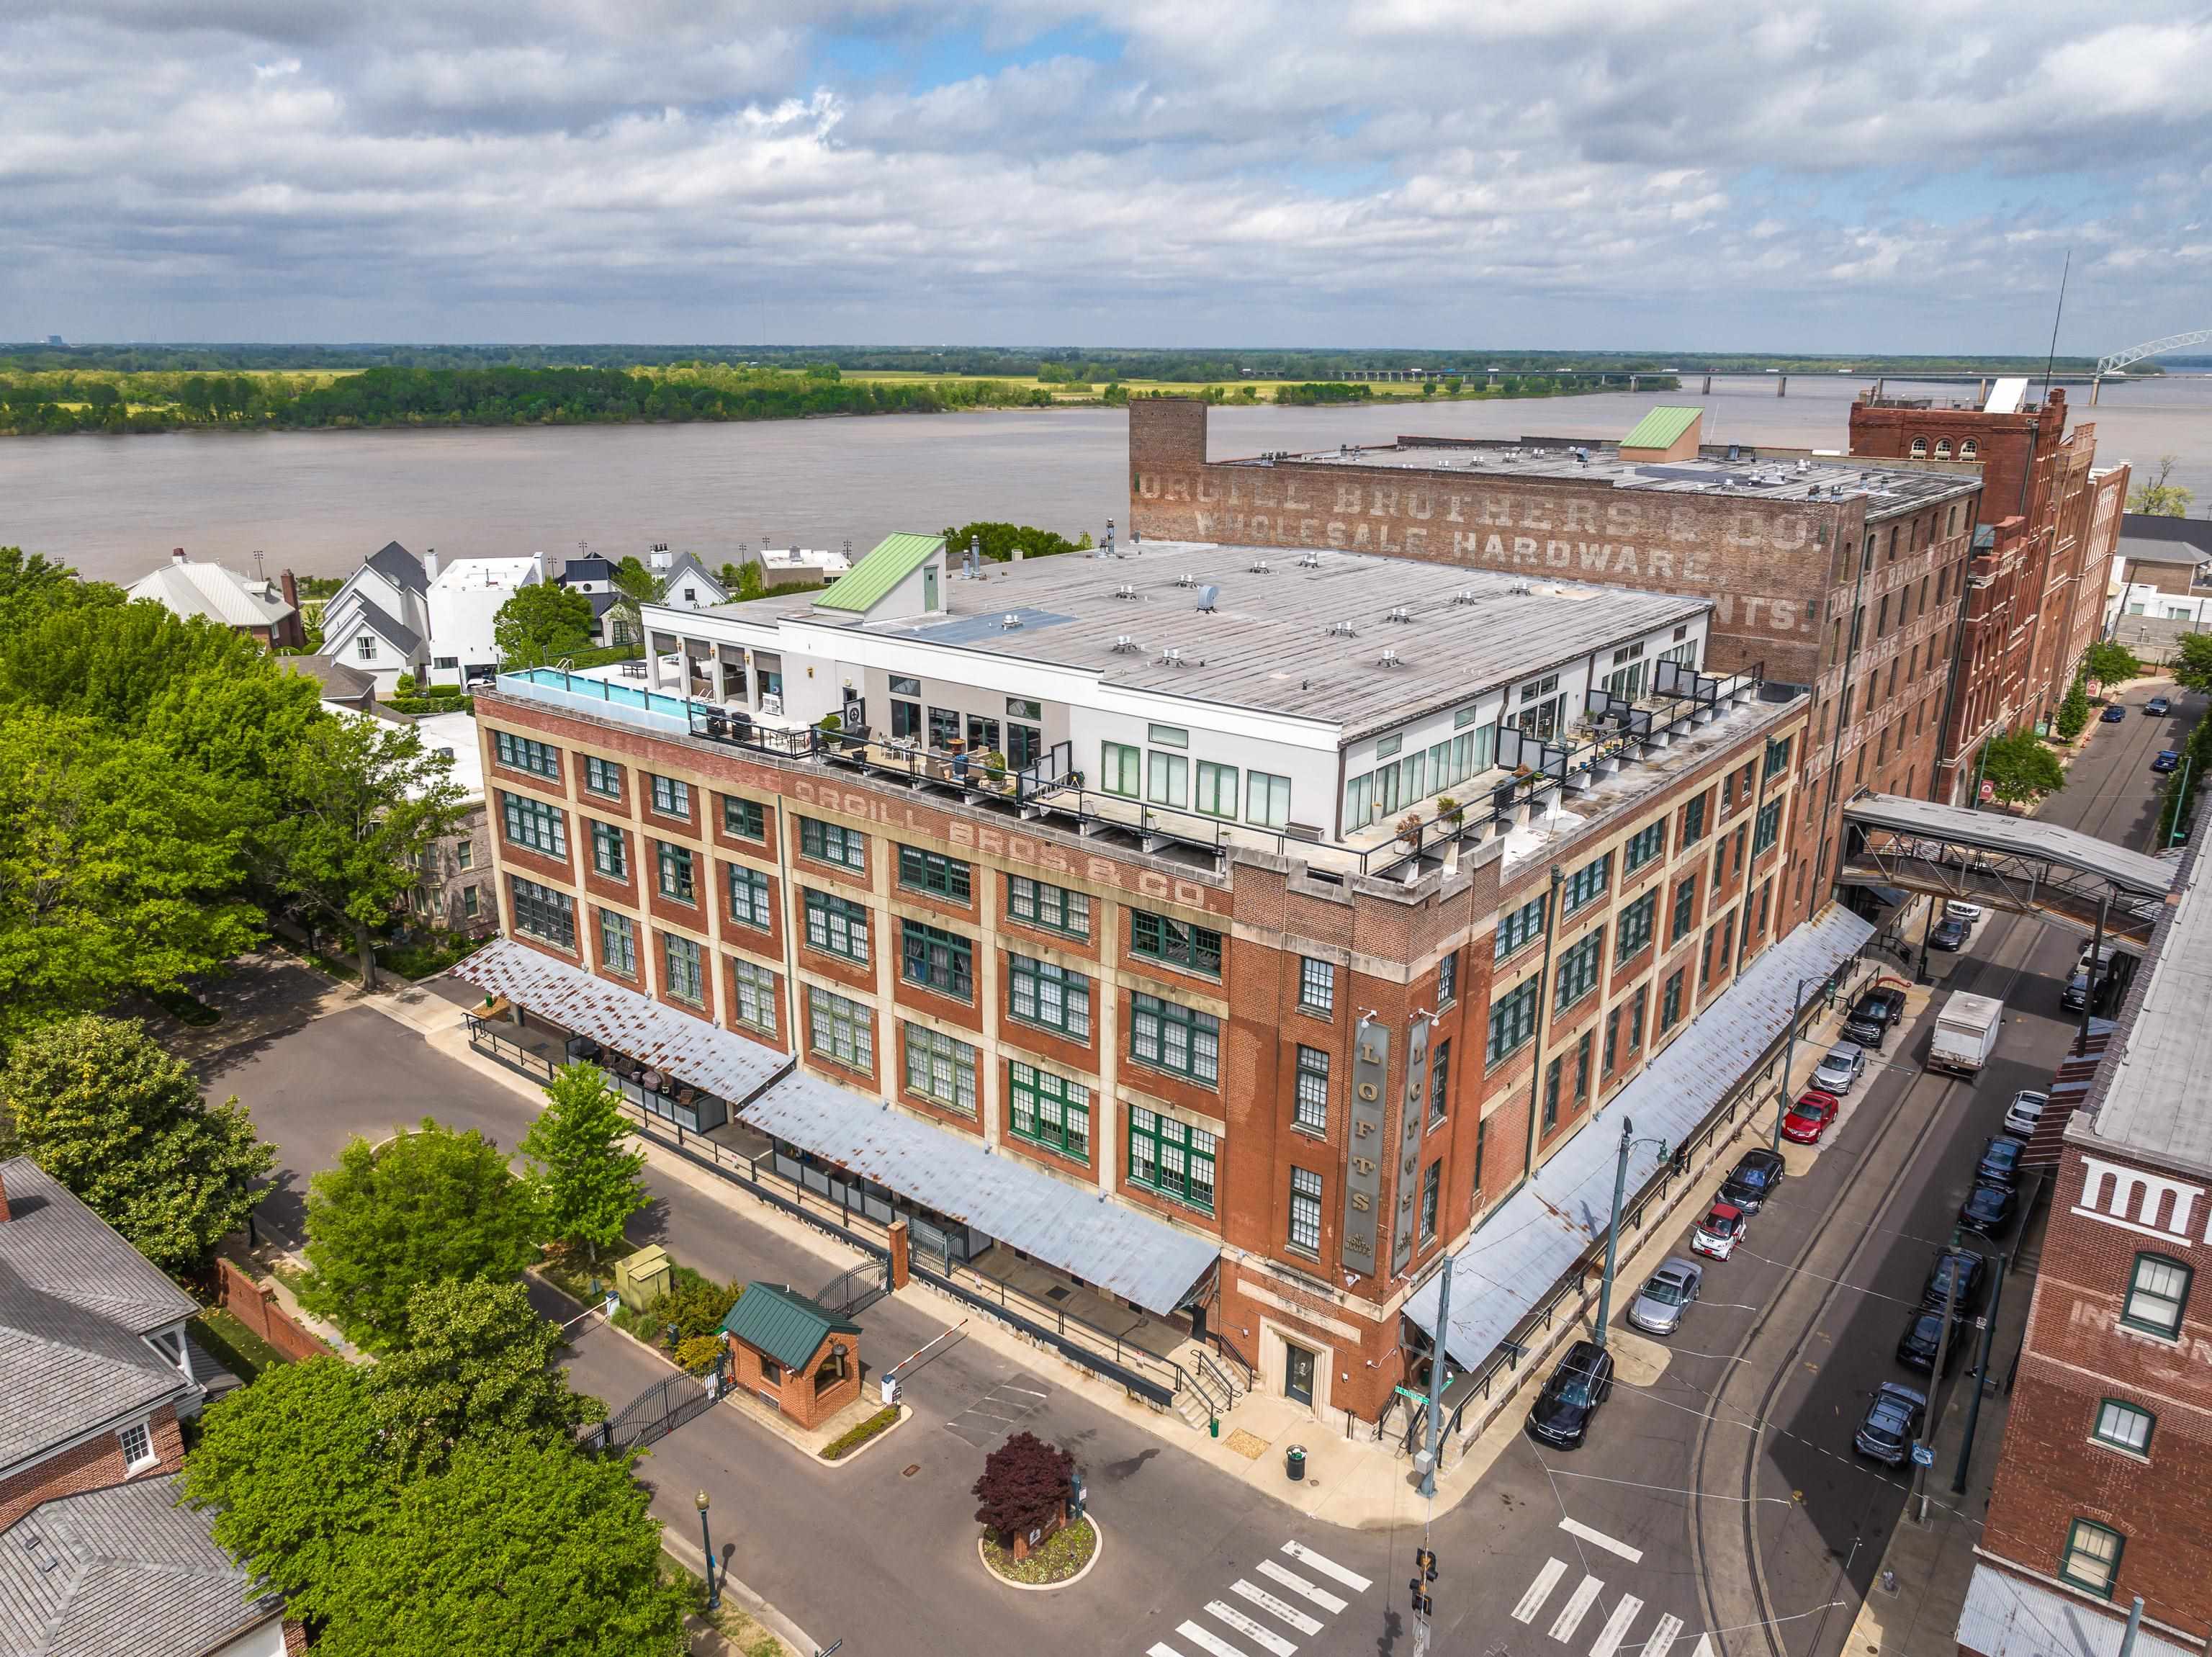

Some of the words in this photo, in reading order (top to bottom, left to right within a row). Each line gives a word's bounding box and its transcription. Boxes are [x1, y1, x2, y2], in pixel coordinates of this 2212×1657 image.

[1195, 511, 1428, 554] WHOLESALE
[1333, 483, 1642, 536] BROTHERS
[794, 781, 931, 835] ORGILL
[950, 821, 1076, 875] BROS.
[1352, 1043, 1381, 1213] LOFTS
